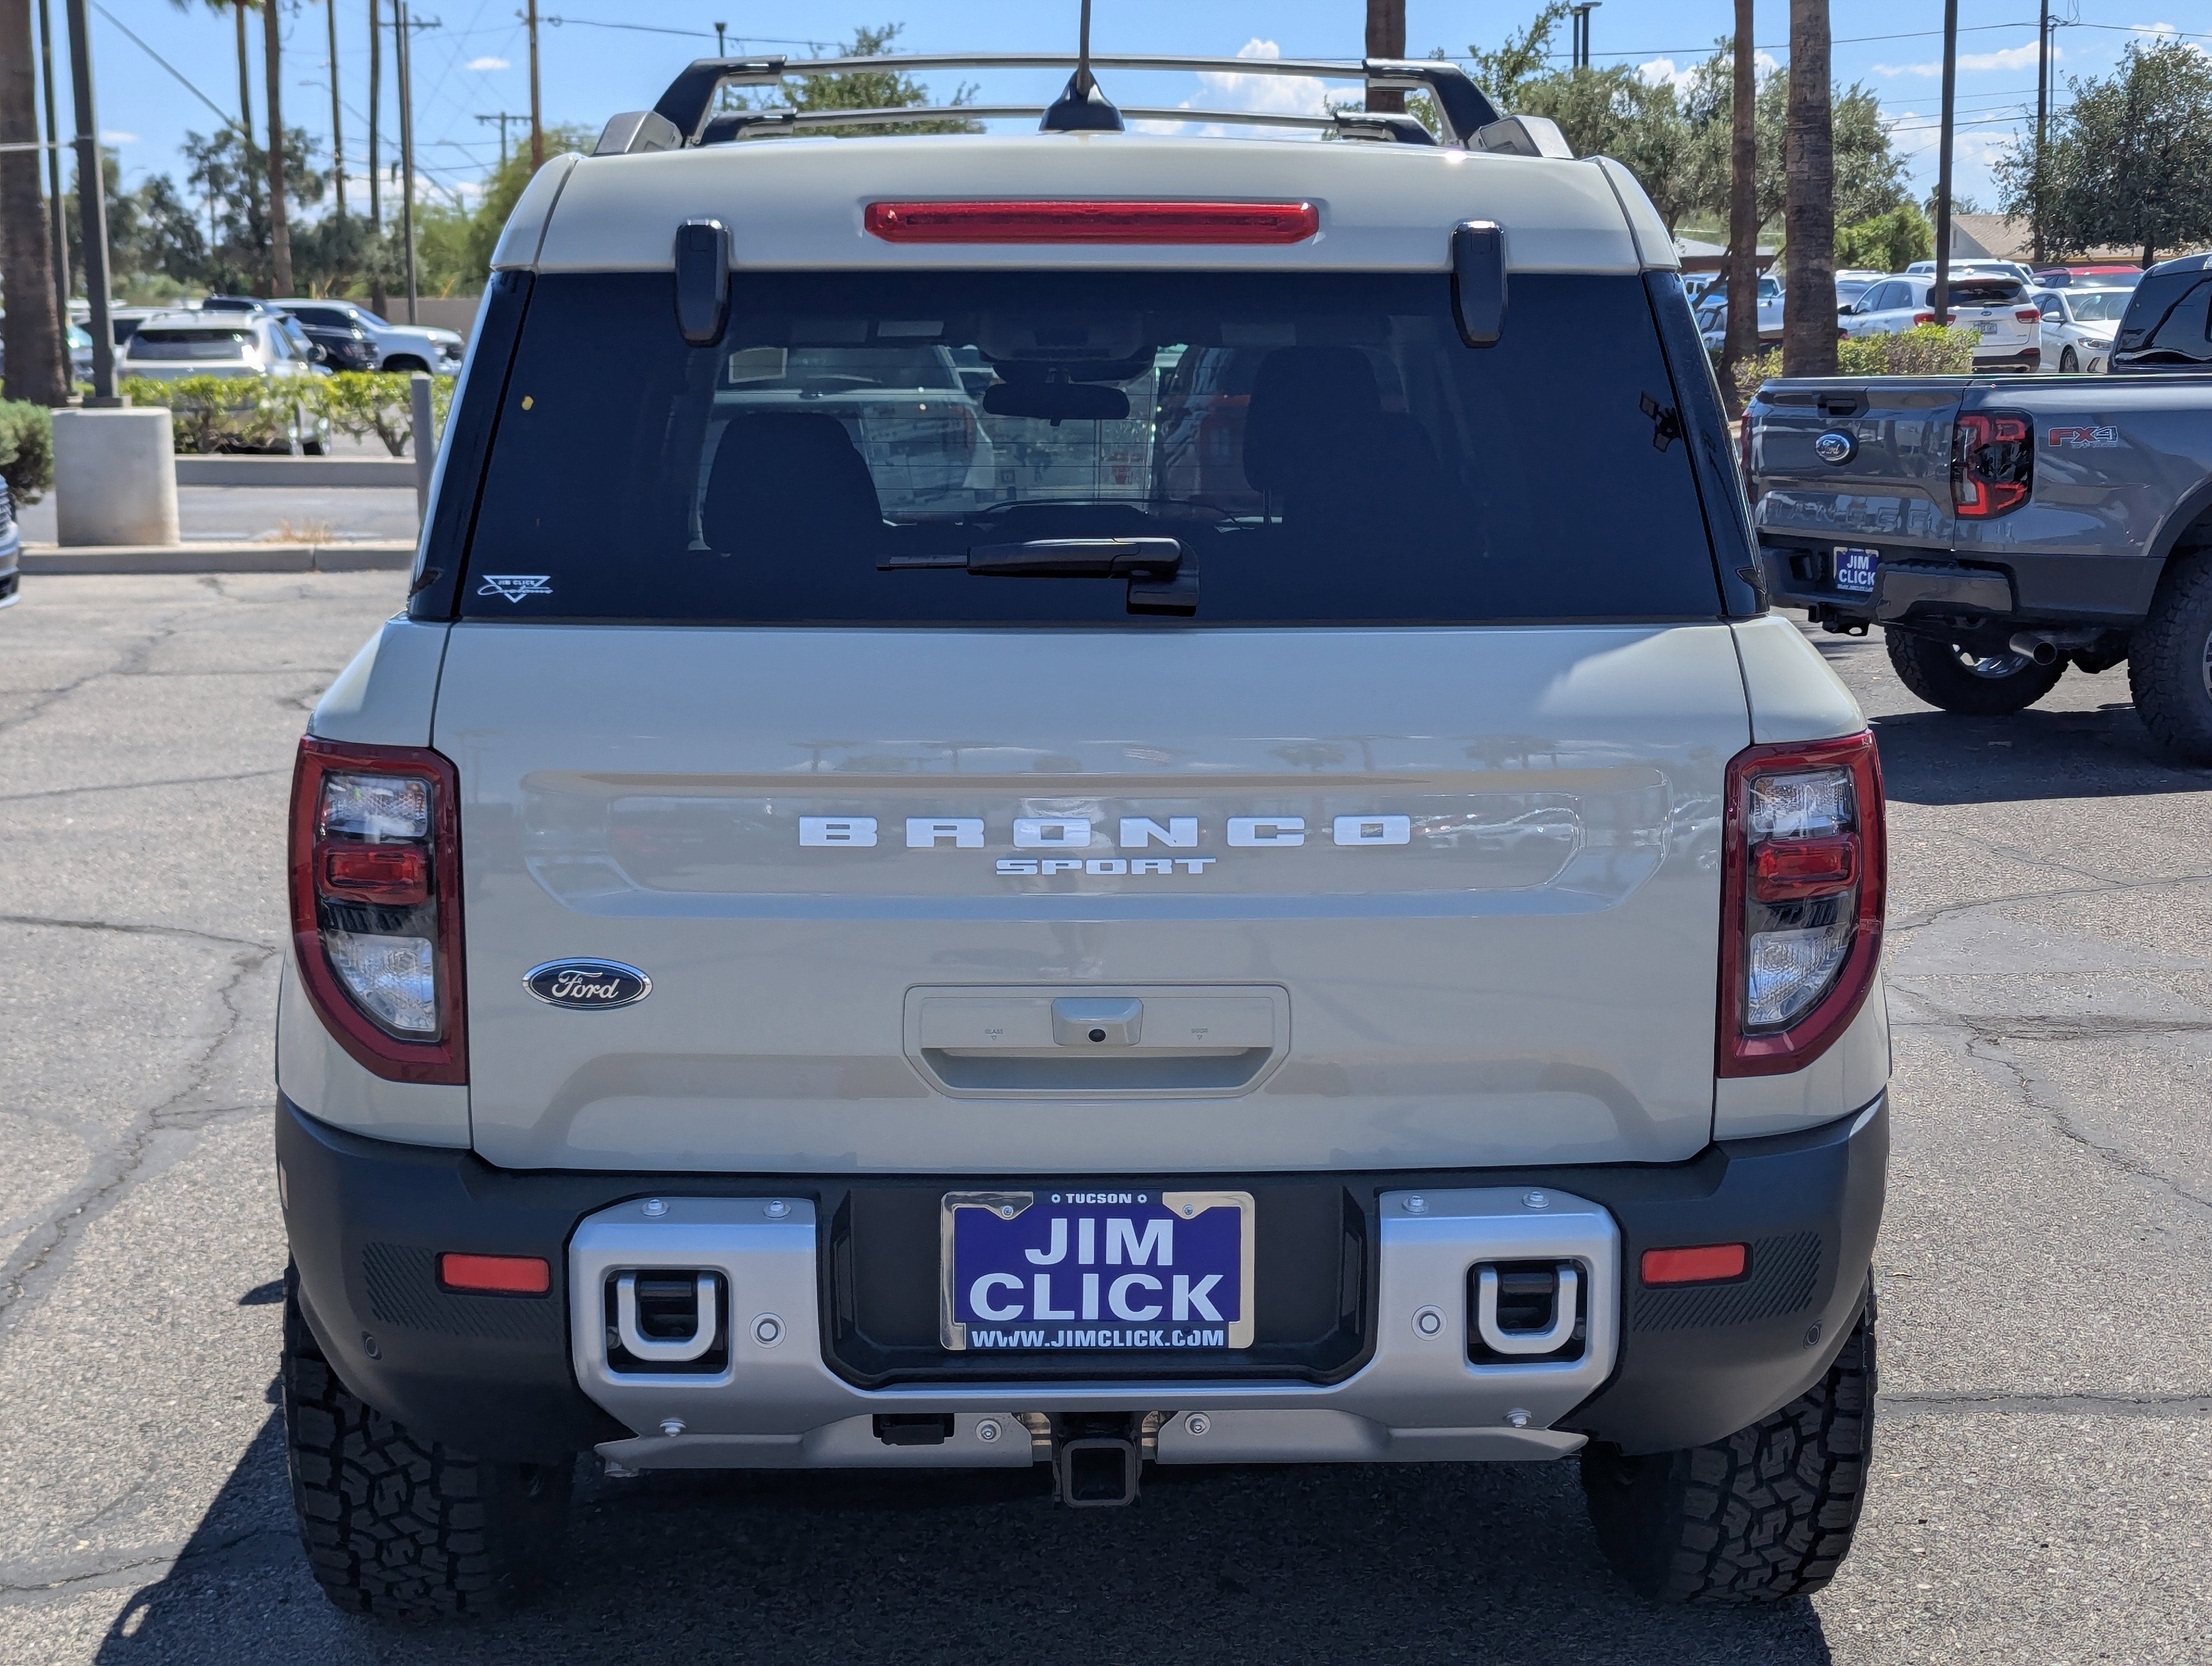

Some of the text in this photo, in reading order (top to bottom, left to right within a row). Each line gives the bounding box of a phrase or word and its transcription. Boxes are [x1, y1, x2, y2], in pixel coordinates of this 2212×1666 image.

[2048, 426, 2118, 447] FX4
[1821, 439, 1841, 455] Ford
[1847, 555, 1869, 570] JIM
[1838, 568, 1876, 586] CLICK
[799, 815, 1411, 849] BRONCO
[995, 856, 1217, 876] SPORT
[551, 970, 620, 999] Ford
[1066, 1193, 1132, 1204] TUCSON
[1025, 1218, 1174, 1266] JIM
[969, 1273, 1225, 1322] CLICK
[972, 1329, 1225, 1348] WWW.JIMCLICK.COM
